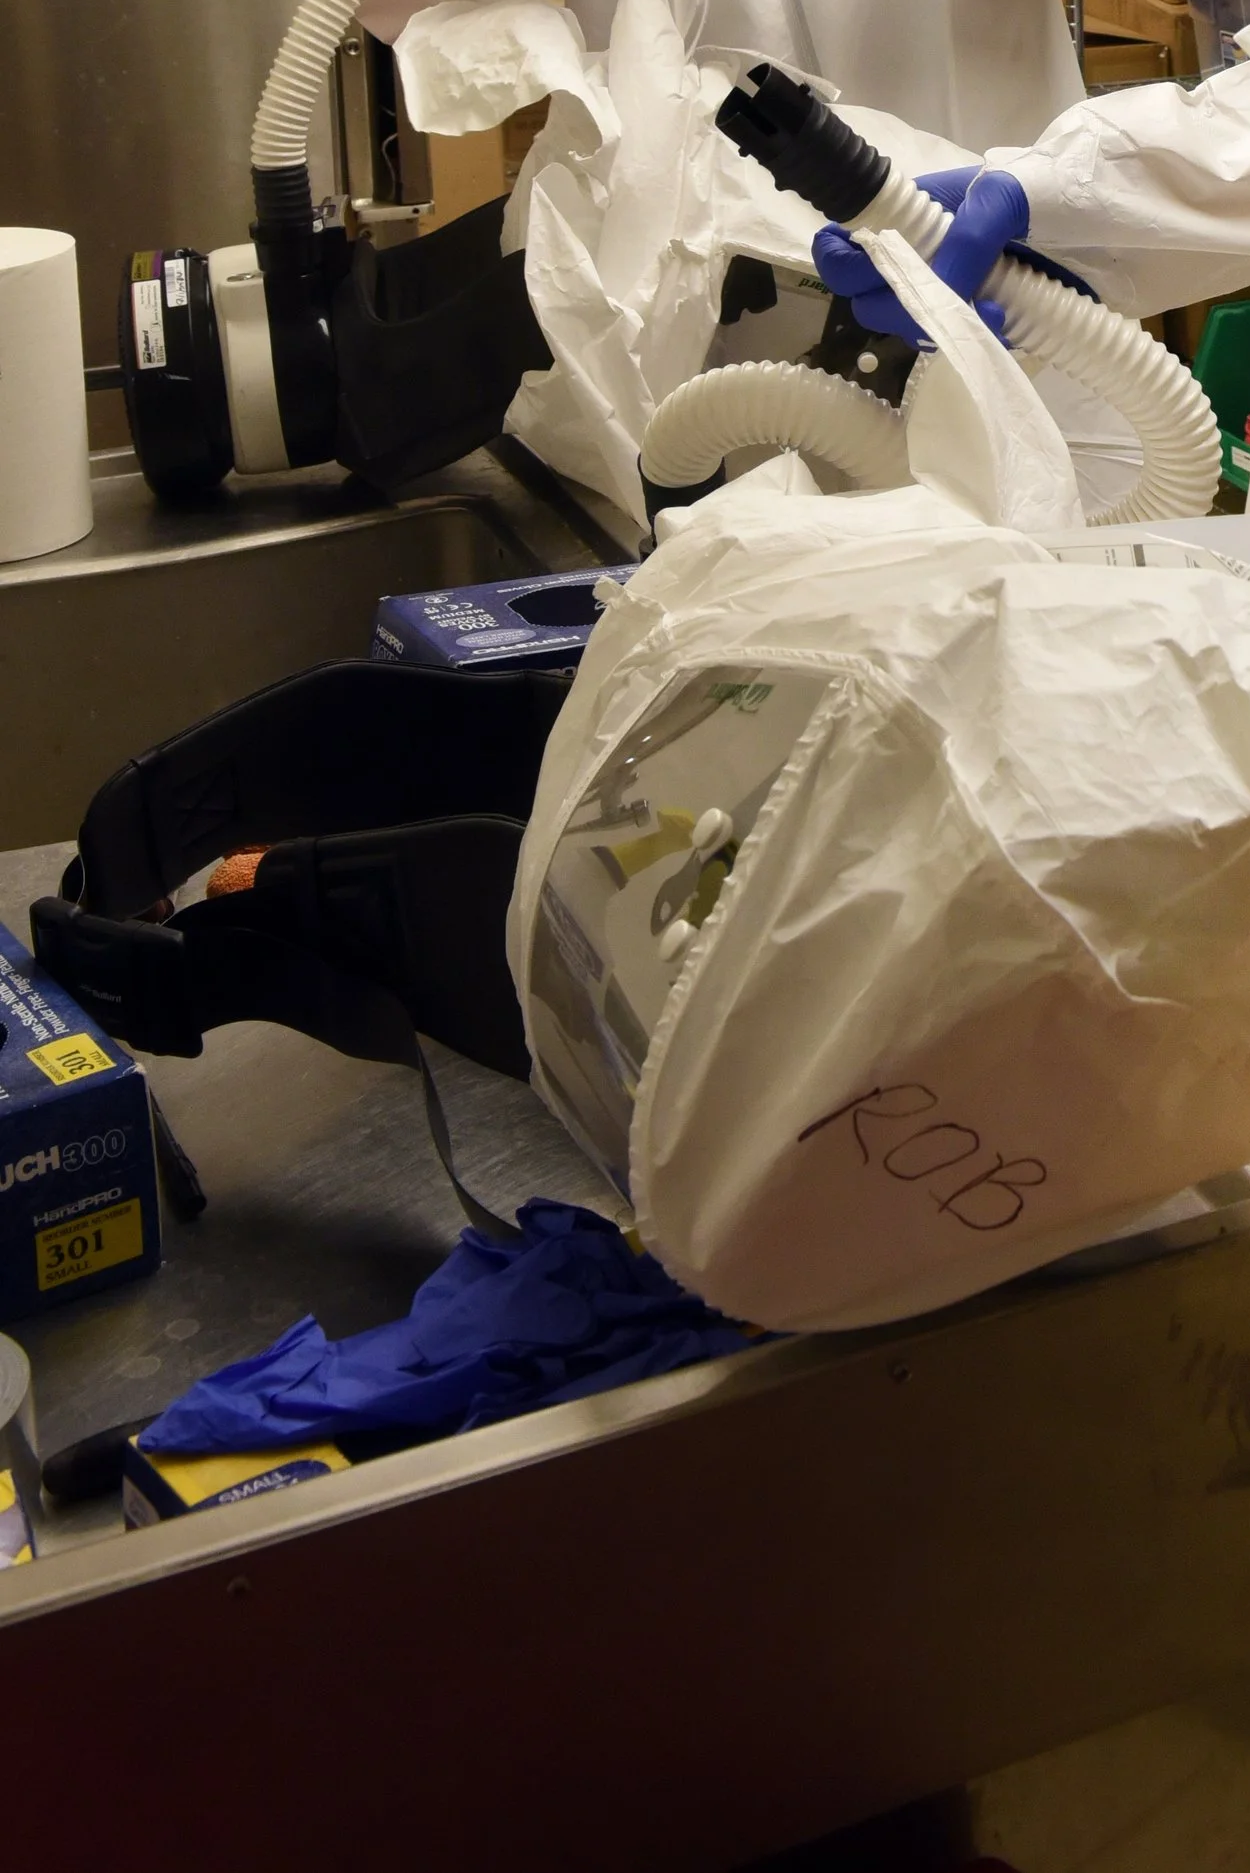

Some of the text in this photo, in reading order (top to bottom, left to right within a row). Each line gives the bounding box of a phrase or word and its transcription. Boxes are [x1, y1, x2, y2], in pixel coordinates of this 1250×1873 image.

[428, 608, 486, 621] MEDIUM
[458, 620, 499, 631] 300
[11, 1001, 52, 1042] Non-Sterile
[40, 1008, 70, 1035] Powder
[56, 1049, 95, 1075] 301
[797, 1084, 1047, 1231] ROB
[33, 1186, 123, 1227] HandPRO
[46, 1229, 105, 1269] 301
[46, 1260, 92, 1283] SMALL
[218, 1472, 291, 1505] SMALL
